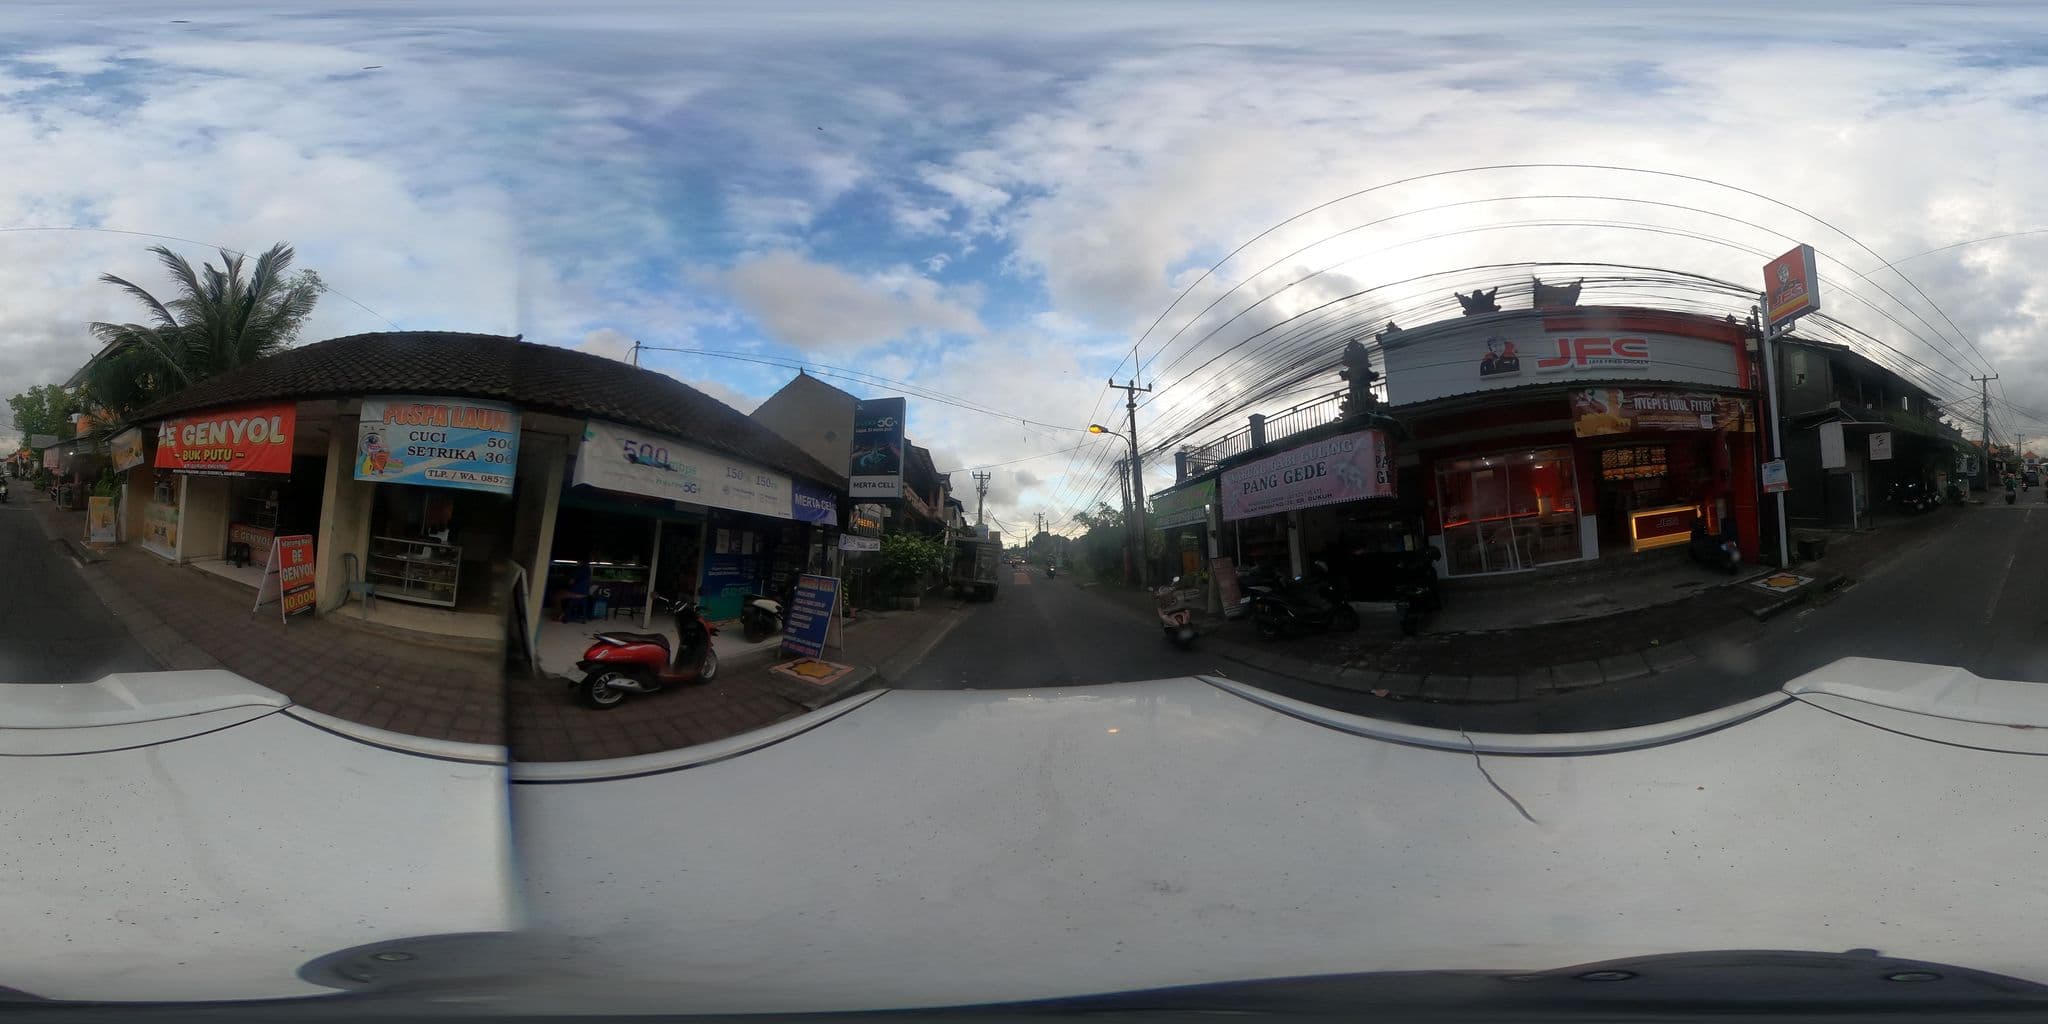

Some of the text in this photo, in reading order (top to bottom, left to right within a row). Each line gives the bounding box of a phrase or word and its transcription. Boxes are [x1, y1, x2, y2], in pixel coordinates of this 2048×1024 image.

[1537, 338, 1649, 368] JFC
[1634, 398, 1661, 410] NYEPI
[1670, 400, 1689, 411] IDUL
[383, 403, 448, 427] PUSPA
[181, 415, 285, 447] GENYOL
[409, 431, 448, 444] CUCI
[182, 448, 233, 462] BUK PUTU
[407, 445, 477, 461] SETRIKA
[853, 481, 896, 489] MERTA CELL
[1243, 461, 1328, 495] PANG GEDE
[794, 493, 820, 509] MERTA
[292, 549, 303, 564] BE
[284, 590, 315, 609] 10.000
